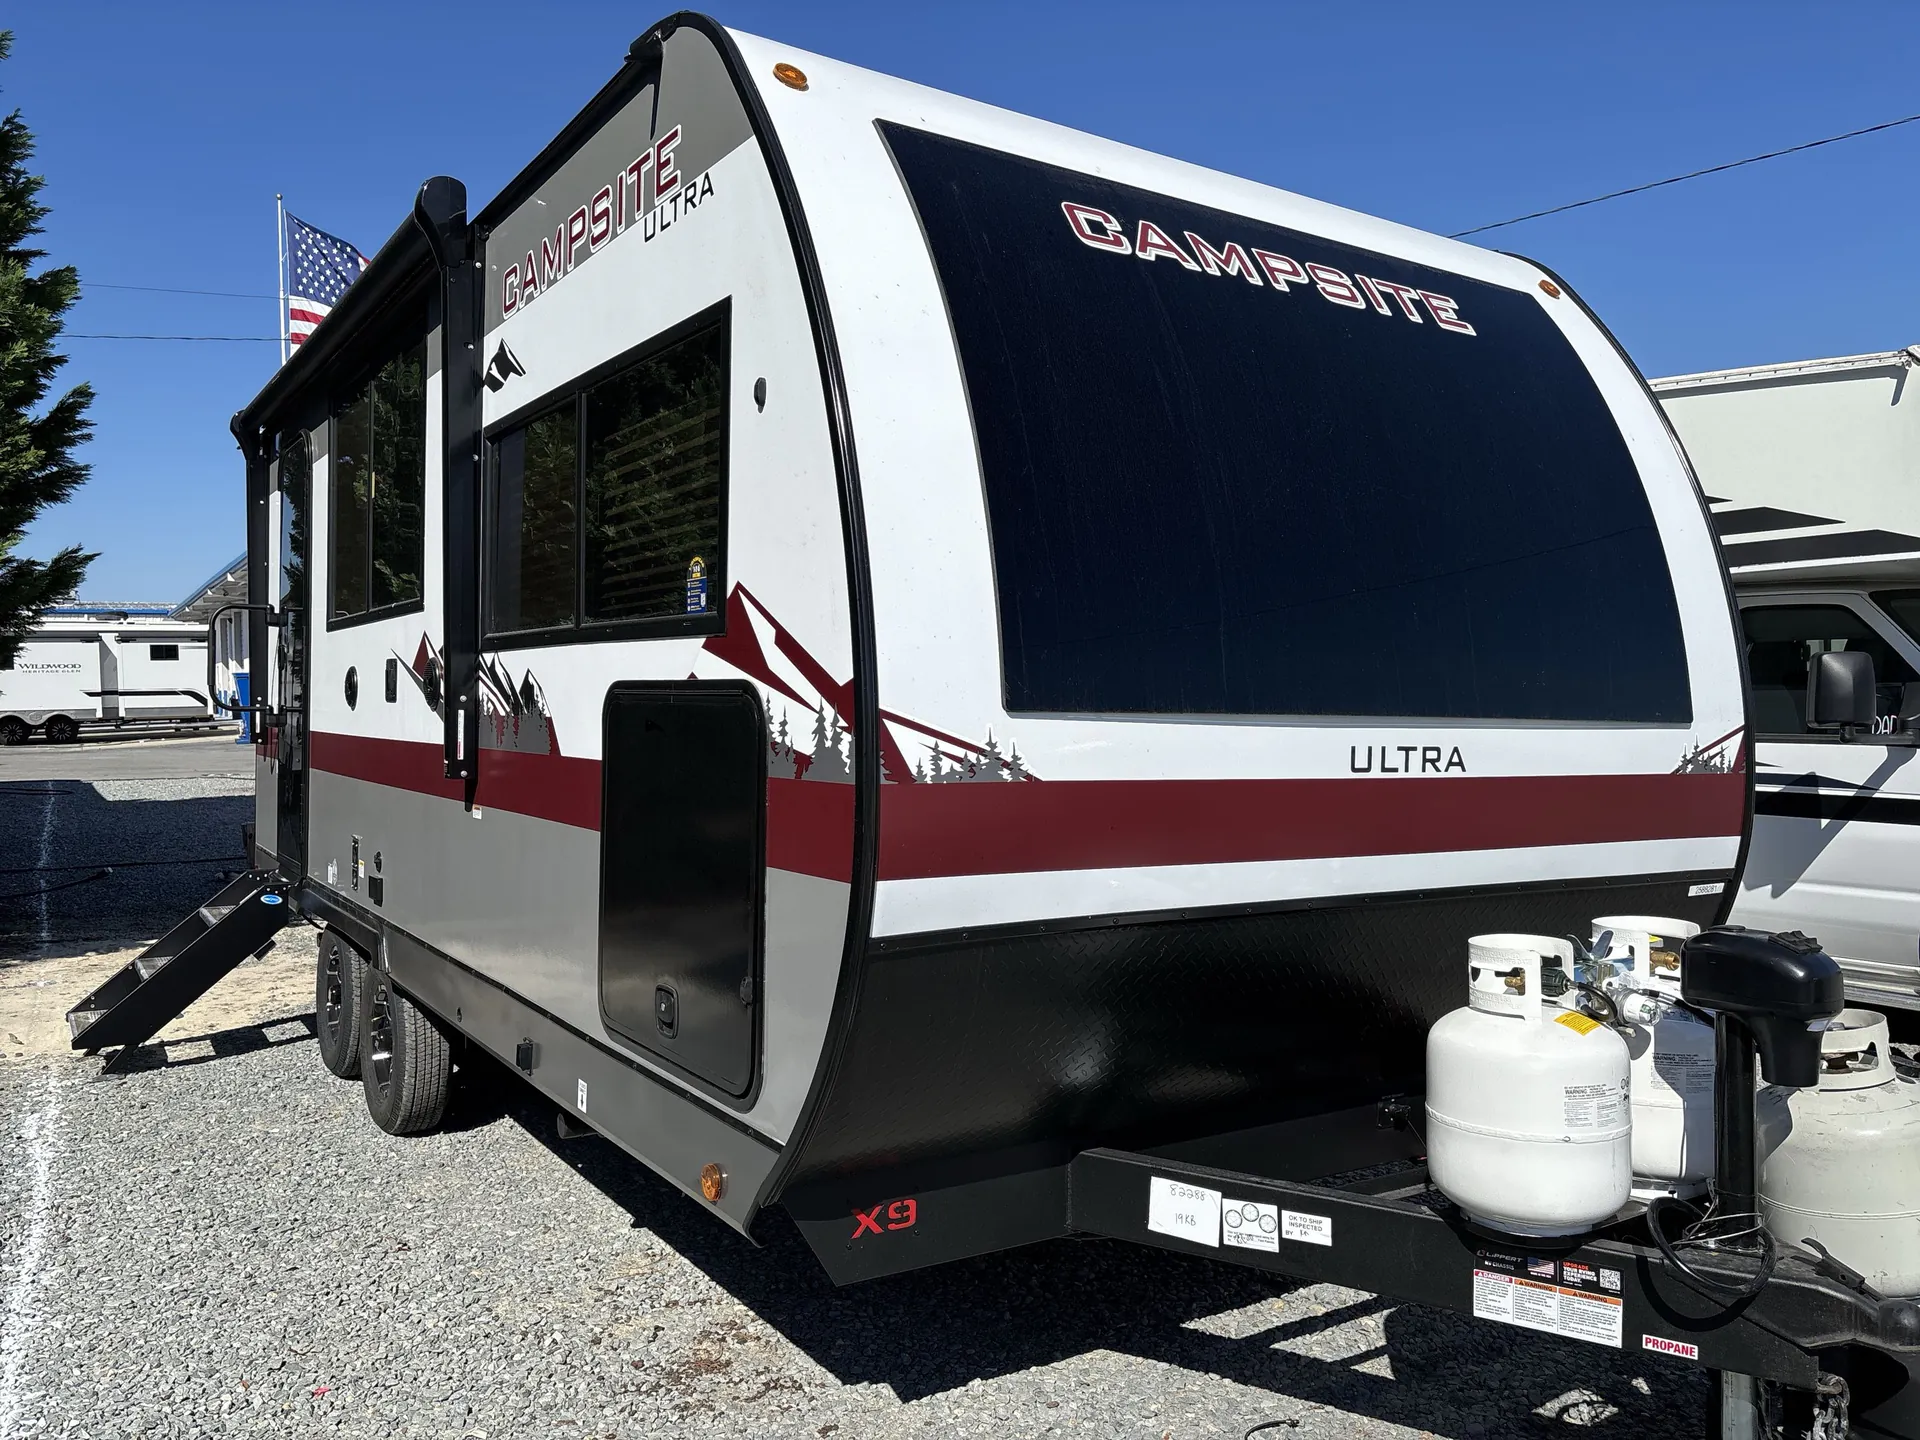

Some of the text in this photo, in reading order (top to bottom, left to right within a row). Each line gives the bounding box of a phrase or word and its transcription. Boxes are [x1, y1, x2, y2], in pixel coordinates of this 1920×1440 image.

[643, 171, 715, 243] ULTRA
[502, 124, 682, 320] CAMPSITE
[1060, 201, 1477, 337] CAMPSITE
[1350, 745, 1467, 774] ULTRA
[850, 1199, 917, 1240] X9
[1288, 1214, 1298, 1222] OK
[1308, 1217, 1323, 1226] SHIP
[1288, 1221, 1323, 1232] INSPECTED
[1483, 1272, 1510, 1283] DANGER
[1524, 1280, 1553, 1292] WARNING
[1578, 1291, 1608, 1303] WARNING
[1644, 1336, 1697, 1357] PROPANE
